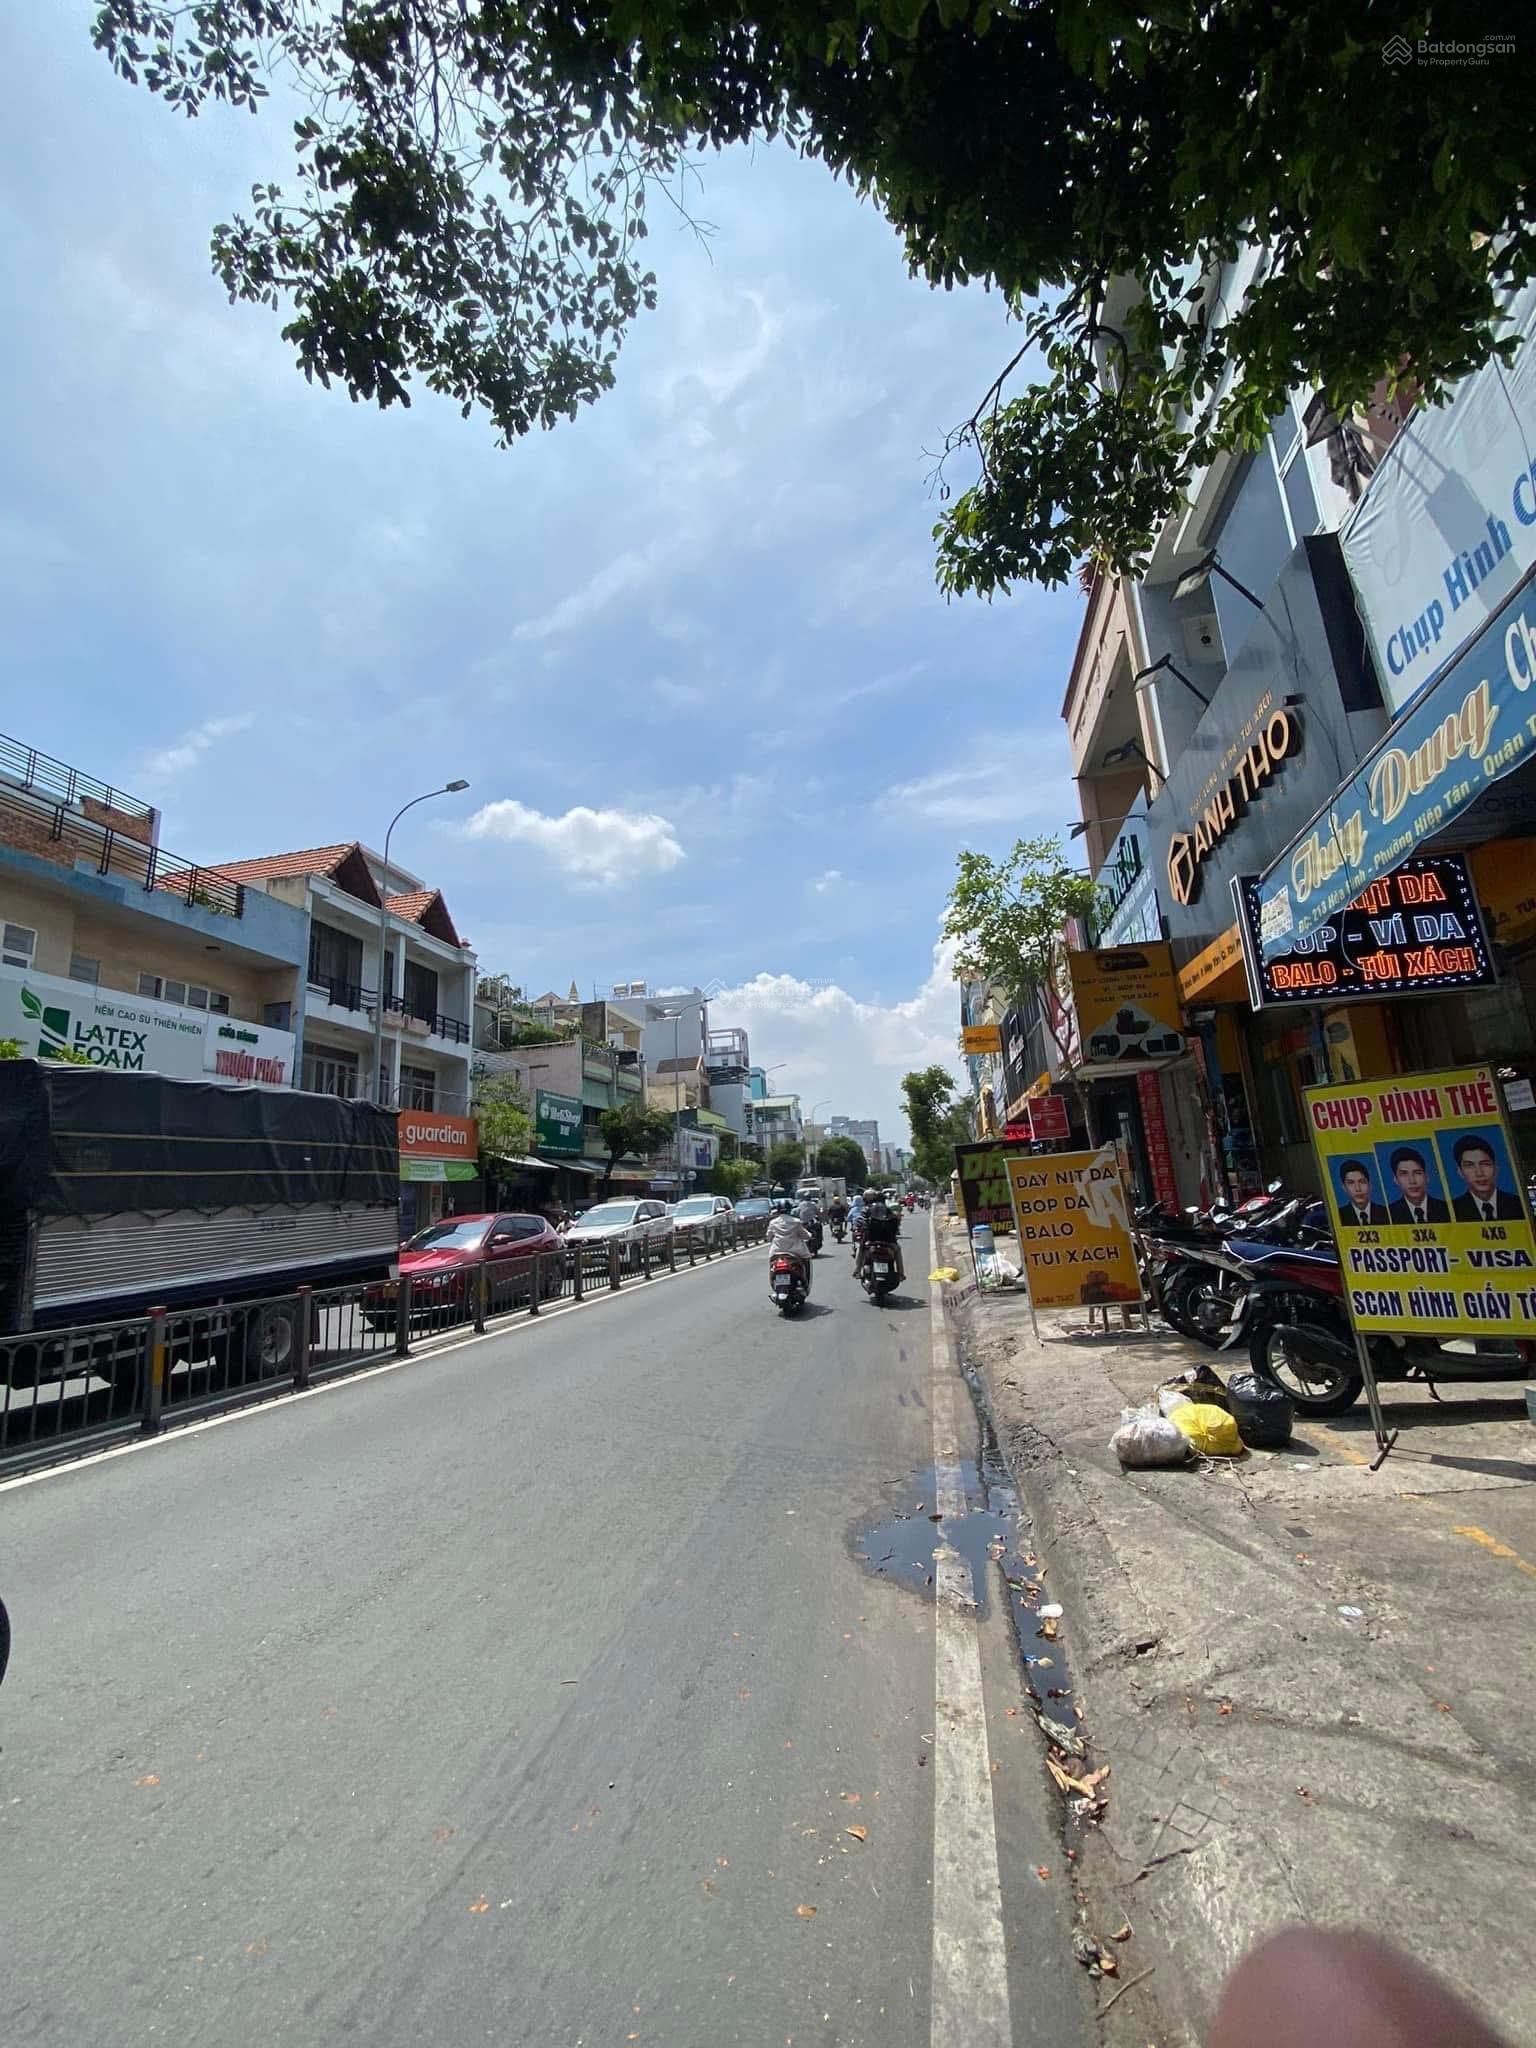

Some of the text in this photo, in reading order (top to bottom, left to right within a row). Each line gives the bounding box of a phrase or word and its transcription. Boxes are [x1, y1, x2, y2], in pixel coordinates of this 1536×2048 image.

[1387, 599, 1445, 676] Chụp
[1368, 679, 1500, 825] Dung
[1195, 778, 1236, 863] ANH
[1233, 709, 1289, 803] THO
[1374, 829, 1414, 870] Phường
[1414, 804, 1442, 836] Hiệp
[1442, 781, 1470, 809] Tân
[1483, 732, 1525, 777] Quận
[1397, 873, 1447, 905] DA
[1369, 912, 1407, 946] VÍ
[1413, 913, 1466, 943] DA
[1272, 960, 1337, 989] BALO
[1357, 950, 1401, 981] TÚI
[1404, 945, 1477, 976] XÁCH
[117, 1009, 137, 1022] CAO
[138, 1014, 151, 1025] SU
[75, 1020, 148, 1051] LATEX
[73, 1043, 144, 1071] FOAM
[1311, 1095, 1373, 1134] CHỤP
[1378, 1087, 1442, 1124] HÌNH
[1445, 1071, 1499, 1117] THẺ
[406, 1124, 468, 1145] guardian
[1016, 1167, 1115, 1189] DAY NIT DA
[1021, 1195, 1090, 1214] BOP DA
[1025, 1222, 1074, 1240] BALO
[1357, 1227, 1507, 1244] 2X3 3X4 4X6
[1030, 1246, 1120, 1267] TUI XACH
[1466, 1250, 1533, 1268] VISA
[1352, 1291, 1404, 1317] SCAN
[1408, 1286, 1459, 1318] HÌNH
[1463, 1281, 1512, 1320] GIẤY
